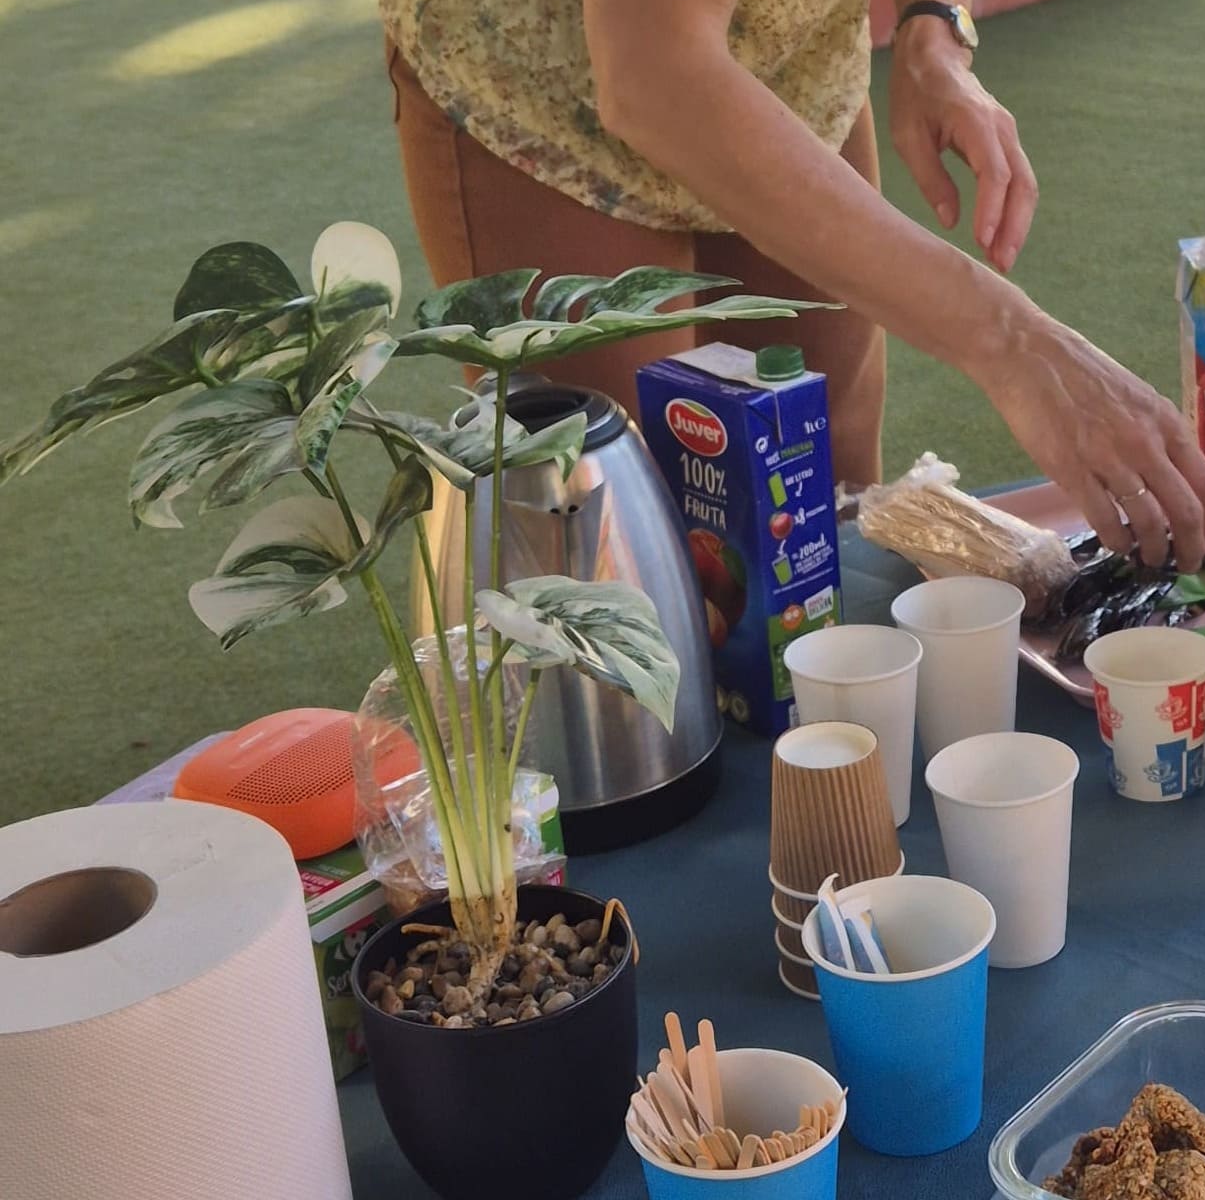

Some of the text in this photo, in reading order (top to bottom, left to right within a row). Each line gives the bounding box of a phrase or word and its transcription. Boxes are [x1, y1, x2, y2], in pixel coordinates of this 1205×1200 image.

[673, 409, 722, 445] Juver
[680, 451, 728, 497] 100%
[684, 493, 727, 531] FRUTA
